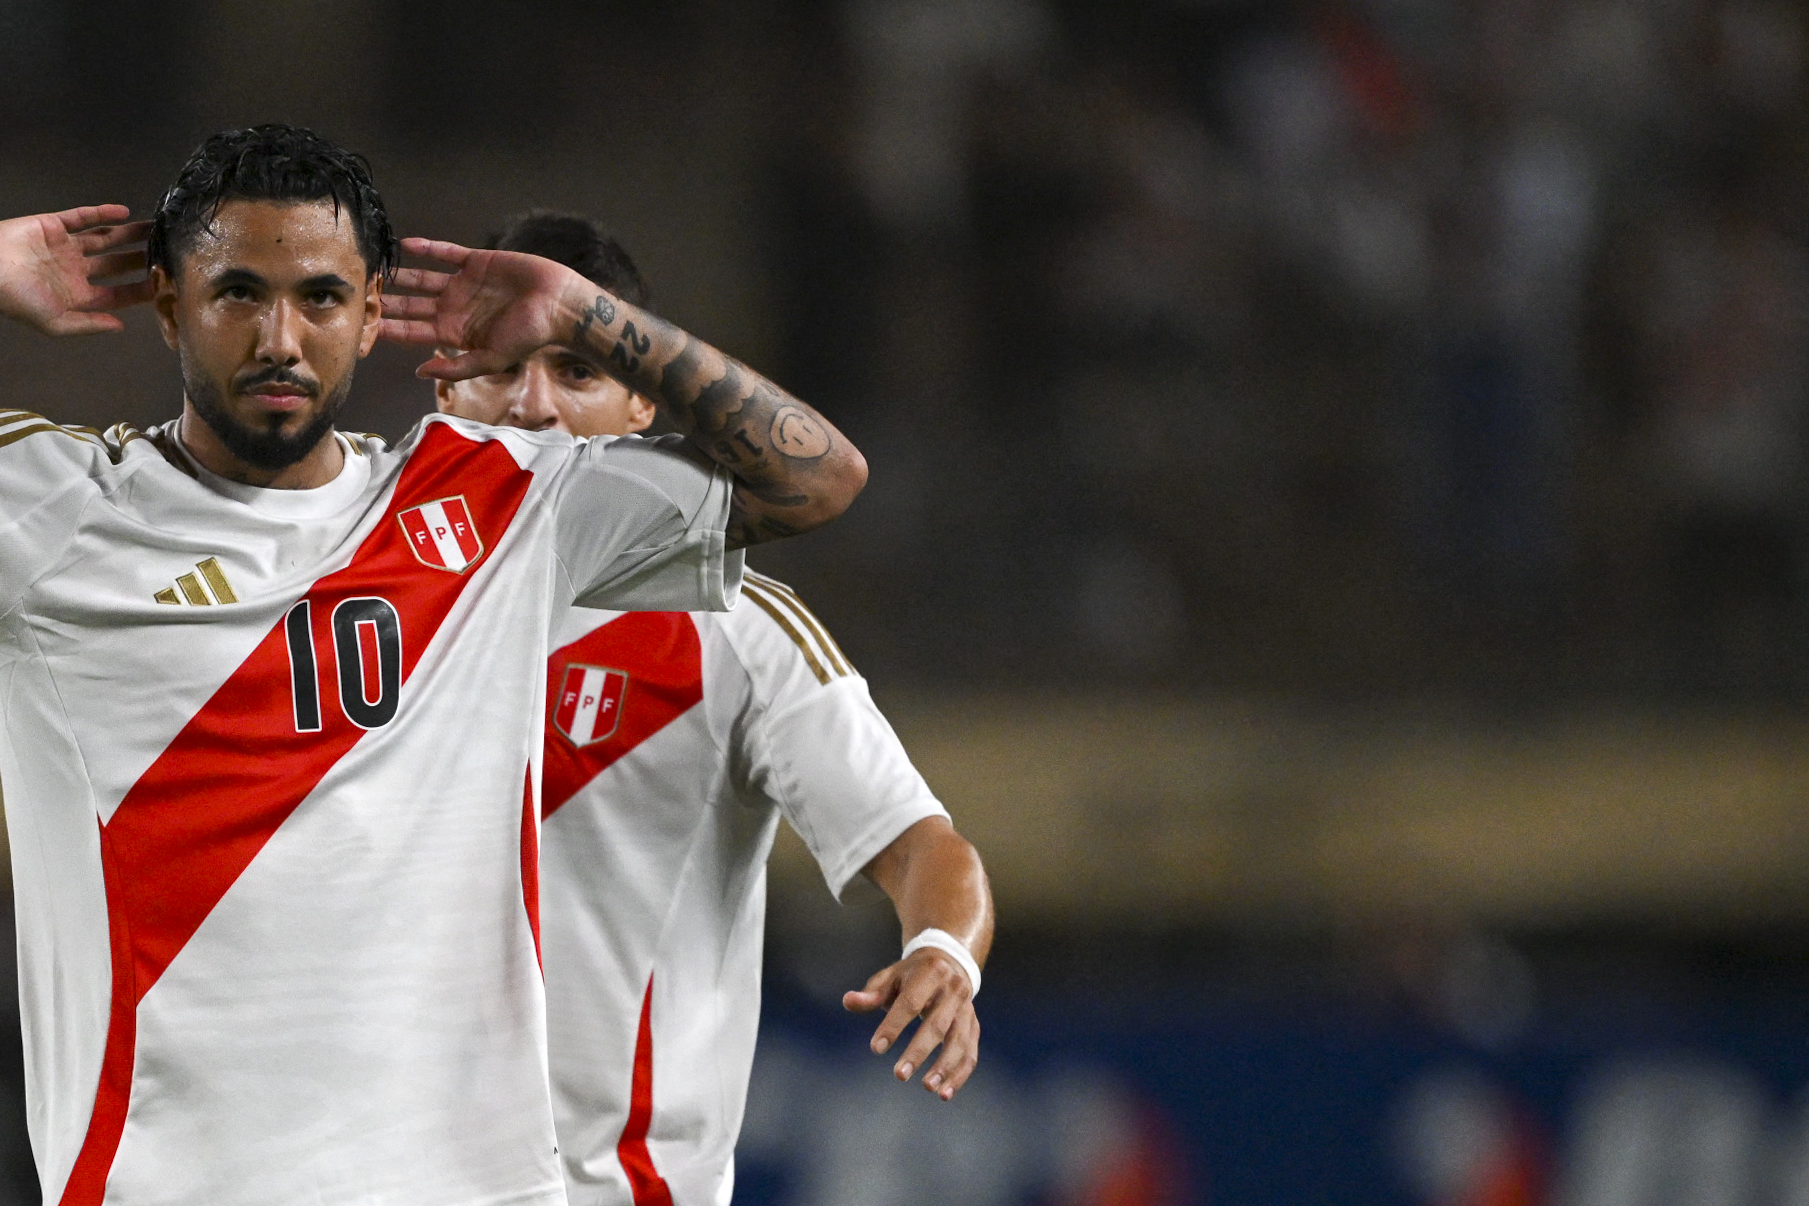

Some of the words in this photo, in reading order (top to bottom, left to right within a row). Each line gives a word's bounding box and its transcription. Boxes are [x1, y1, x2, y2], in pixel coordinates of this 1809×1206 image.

[415, 522, 465, 545] FPF
[285, 596, 401, 733] 10
[564, 692, 614, 713] FPF
